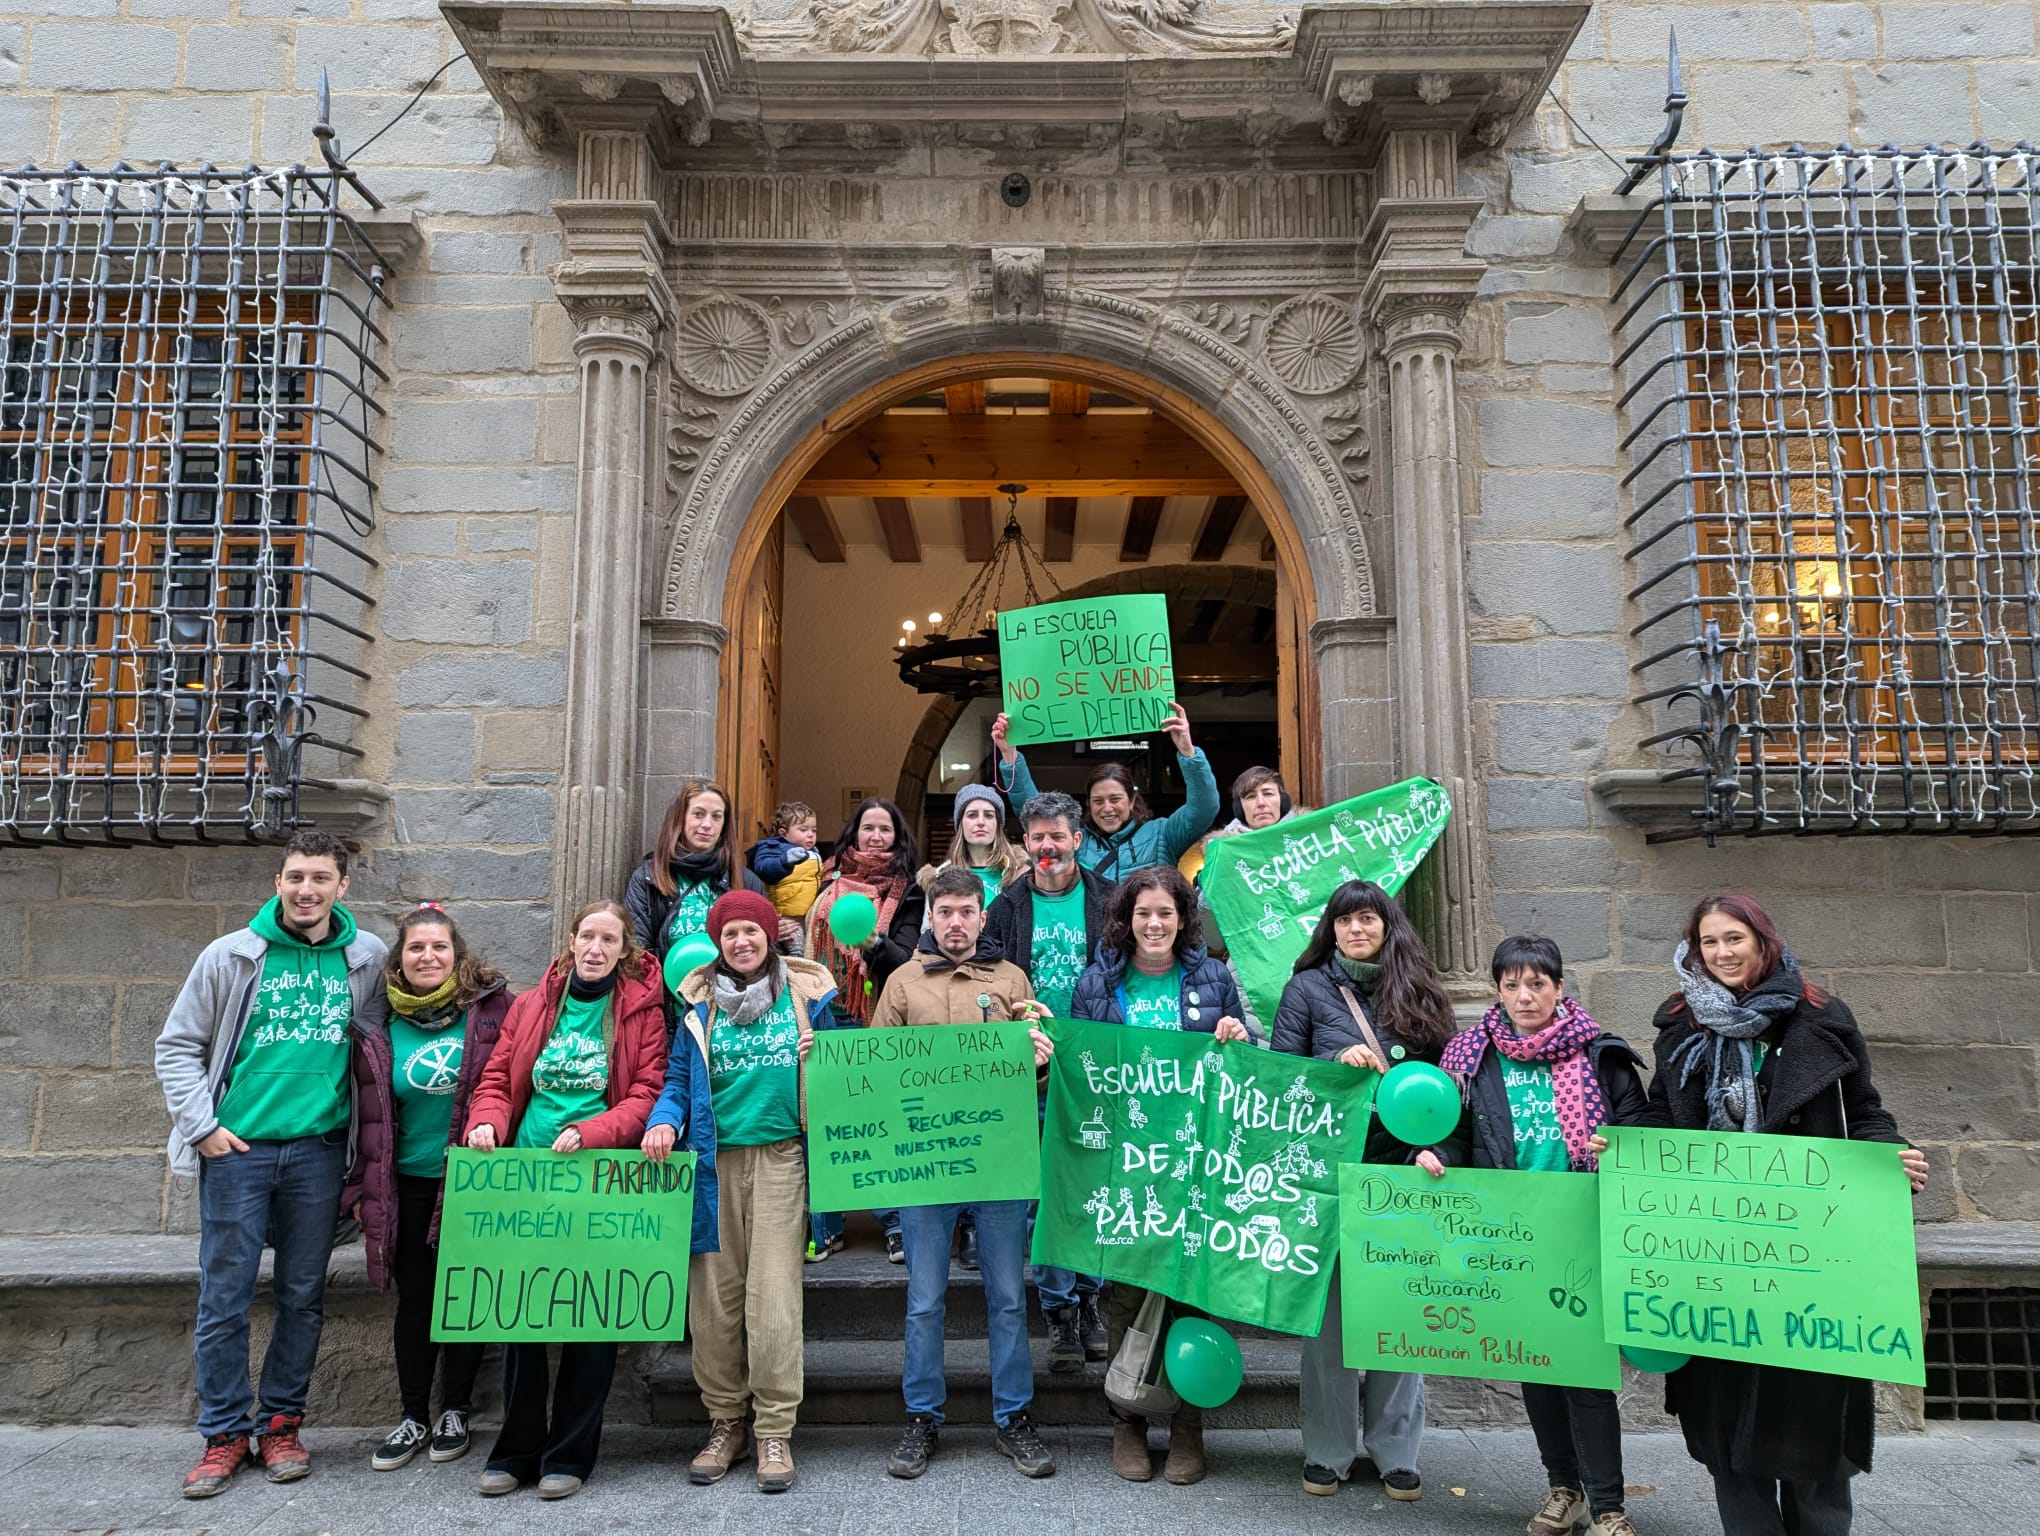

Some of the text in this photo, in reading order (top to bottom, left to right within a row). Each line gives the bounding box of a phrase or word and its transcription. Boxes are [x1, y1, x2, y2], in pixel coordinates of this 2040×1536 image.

[1004, 609, 1117, 641] LA ESCUELA
[1060, 632, 1169, 667] PÚBLICA
[1008, 665, 1175, 704] NO SE VENDE
[1021, 702, 1074, 738] SE
[1243, 823, 1356, 895] ESCUELA
[1355, 791, 1452, 850] PÚBLICA
[1052, 955, 1087, 966] TOD@
[268, 1003, 349, 1020] DE TOD@S
[711, 1033, 796, 1054] DE TOD@S
[957, 1030, 1005, 1055] PARA
[845, 1060, 1028, 1097] LA CONCERTADA
[1085, 1058, 1344, 1137] ESCUELA PÚBLICA:
[825, 1108, 1004, 1142] MENOS RECURSOS
[830, 1134, 983, 1165] PARA NUESTROS
[454, 1158, 693, 1195] DOCENTES PARANDO
[852, 1157, 977, 1189] ESTUDIANTES
[1121, 1142, 1301, 1203] DE TOD@S
[465, 1203, 661, 1241] TAMBIÉN ESTÁN
[1095, 1233, 1135, 1245] Huesca
[1095, 1203, 1320, 1276] PARA TOD@S
[1407, 1273, 1502, 1301] educando
[1630, 1268, 1780, 1294] ESO ES LA
[441, 1266, 675, 1332] EDUCANDO
[1423, 1305, 1476, 1334] SOS
[1623, 1291, 1763, 1349] ESCUELA
